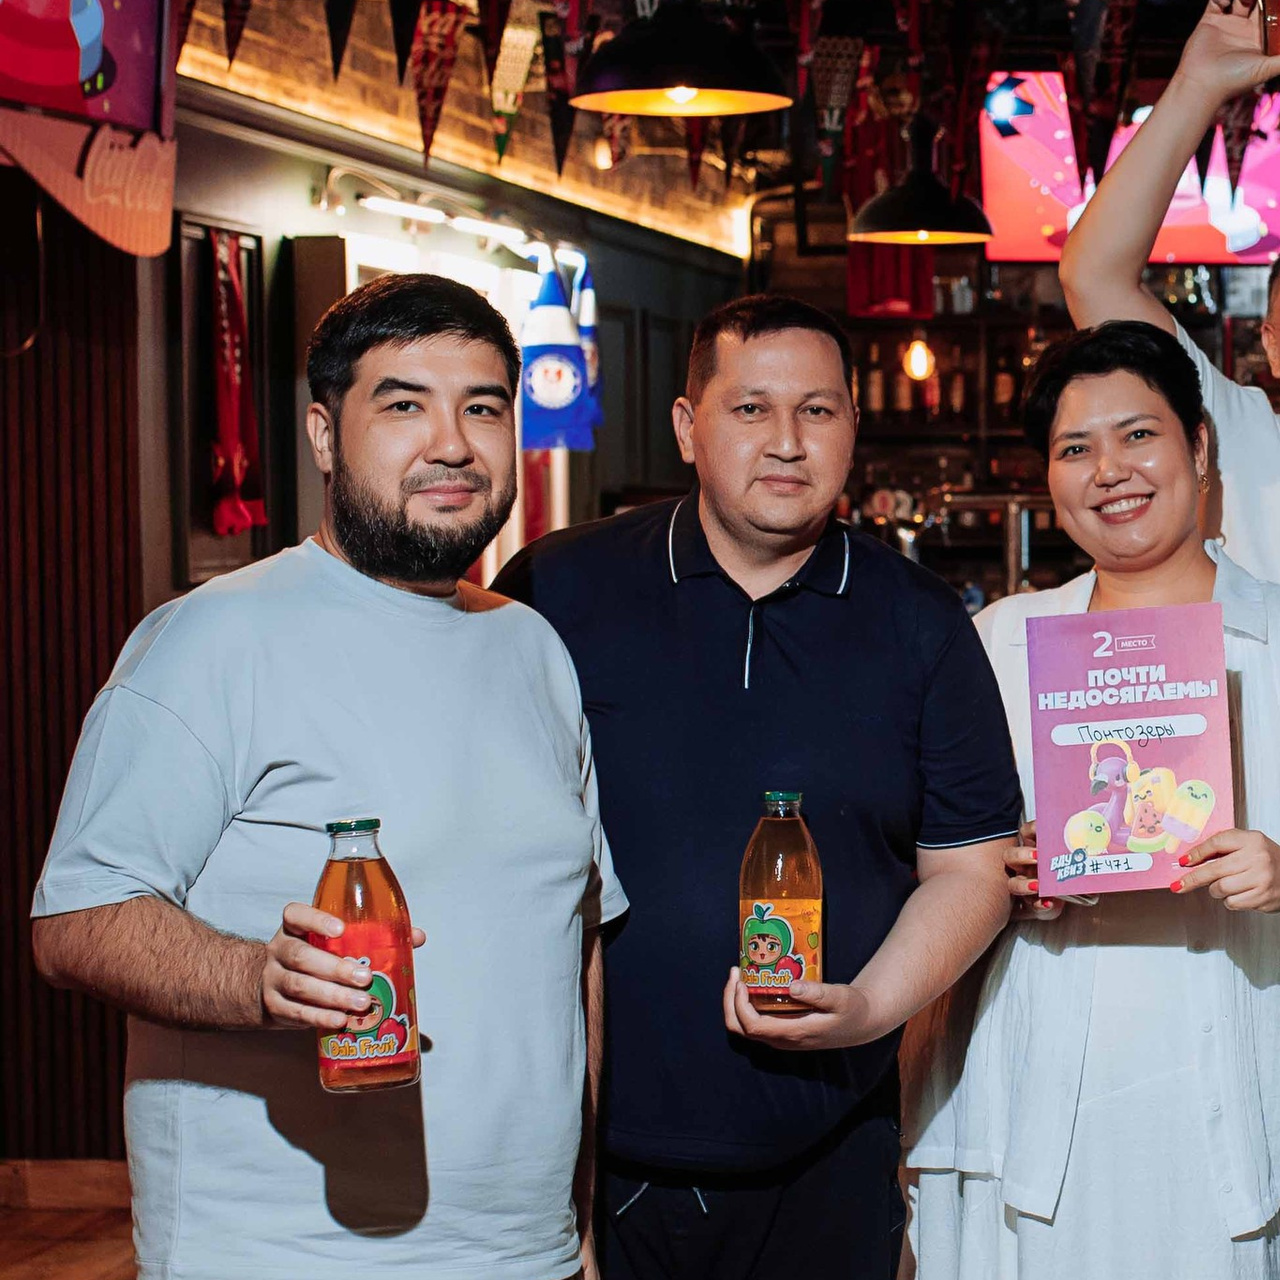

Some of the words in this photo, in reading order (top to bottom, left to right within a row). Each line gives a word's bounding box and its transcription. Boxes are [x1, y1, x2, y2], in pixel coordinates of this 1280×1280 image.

[1093, 631, 1113, 657] 2
[1121, 639, 1148, 649] МЕСТО
[1088, 665, 1166, 688] ПОЧТИ
[1038, 680, 1218, 710] НЕДОСЯГАЕМЫ
[761, 969, 791, 986] Fruit
[329, 1039, 358, 1058] Dala
[359, 1036, 396, 1057] Fruit
